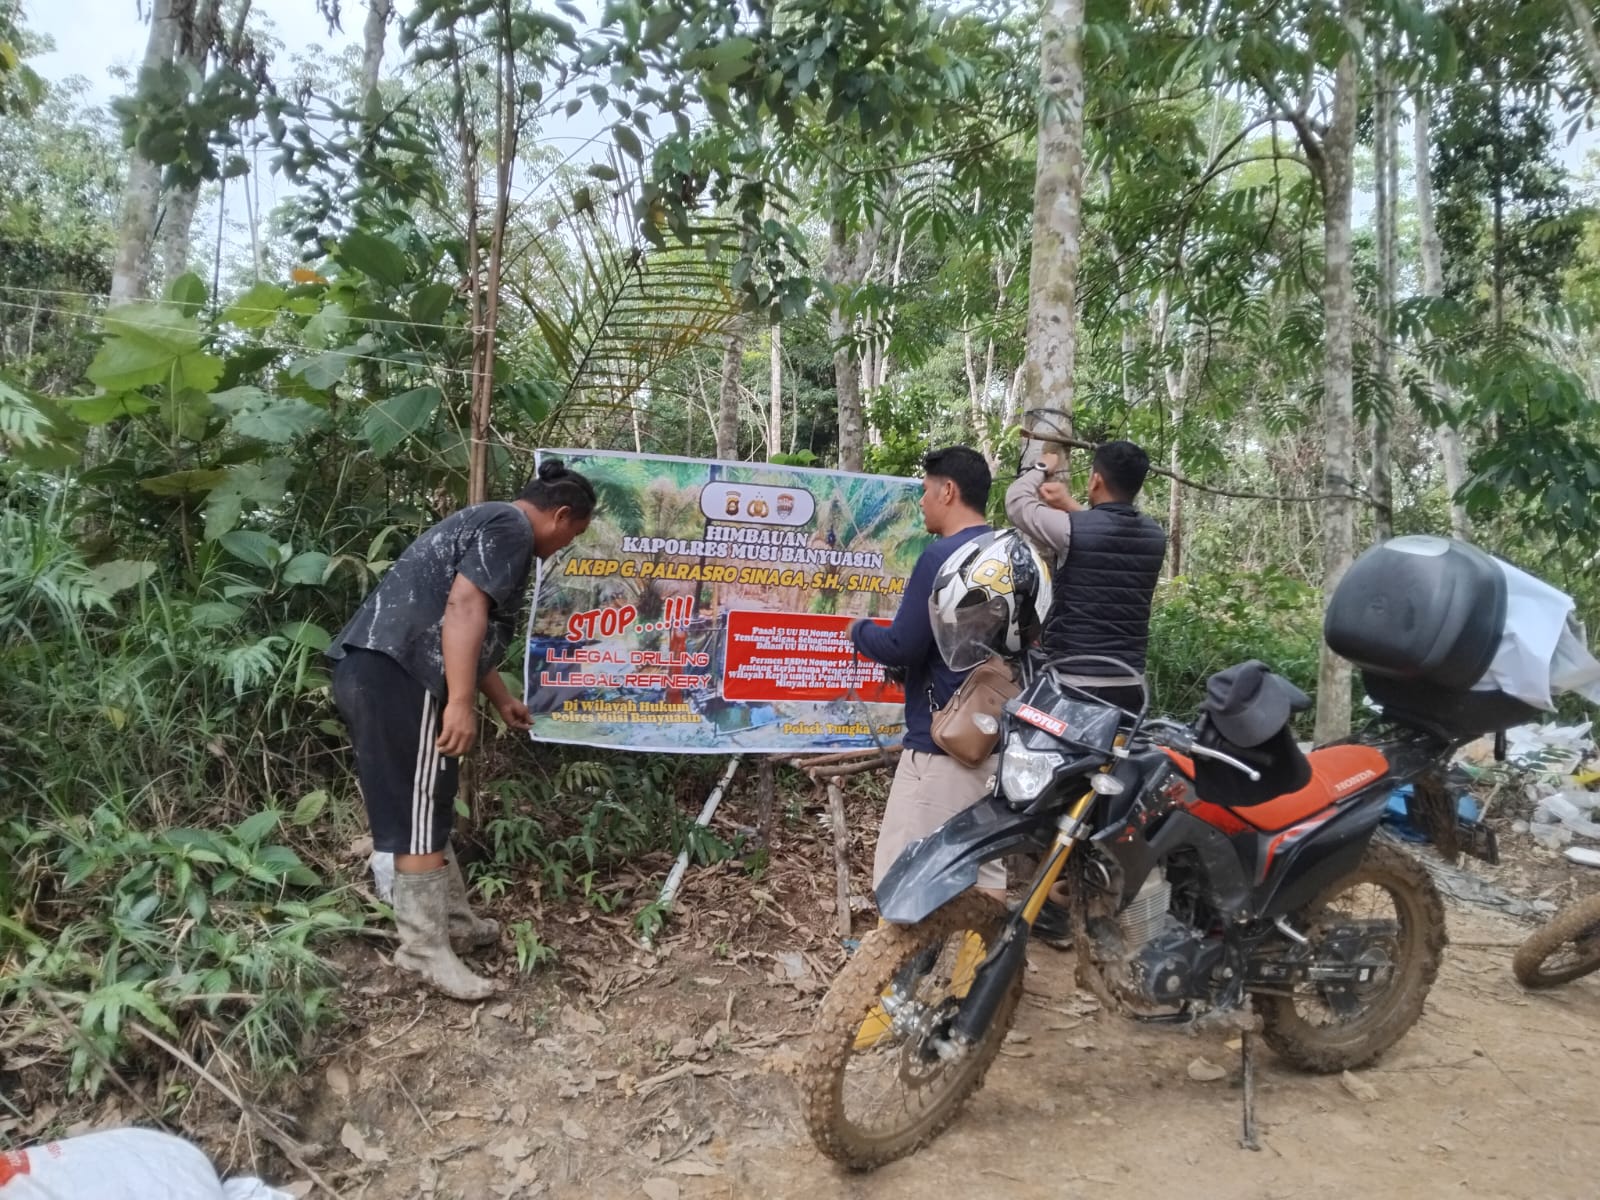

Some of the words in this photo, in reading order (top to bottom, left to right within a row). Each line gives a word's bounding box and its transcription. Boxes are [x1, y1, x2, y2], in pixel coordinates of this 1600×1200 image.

[706, 525, 808, 547] HIMBAUAN
[622, 537, 727, 557] KAPOLRES
[731, 543, 779, 562] MUSI
[780, 546, 883, 568] BANYUASIN
[564, 558, 620, 577] AKBP
[621, 559, 637, 578] G.
[639, 562, 738, 582] PALRASRO
[739, 567, 809, 590] SINAGA,
[811, 571, 843, 593] S.H.,
[734, 633, 770, 643] Tentang
[752, 626, 776, 634] Pasal
[810, 629, 838, 637] Nomor
[809, 644, 837, 652] Nomor
[546, 648, 625, 664] ILLEGAL
[630, 651, 710, 667] DRILLING
[809, 658, 838, 666] Nomor
[541, 672, 621, 688] ILLEGAL
[624, 673, 711, 690] REFINERY
[809, 680, 825, 688] dan
[563, 699, 578, 712] Di
[639, 700, 690, 713] Hukum
[552, 709, 594, 723] Polres
[631, 711, 701, 726] Banyuasin
[1020, 707, 1063, 733] MOTUL
[783, 722, 822, 734] Polsek
[825, 722, 872, 736] Tungka
[1334, 769, 1376, 792] HONDA
